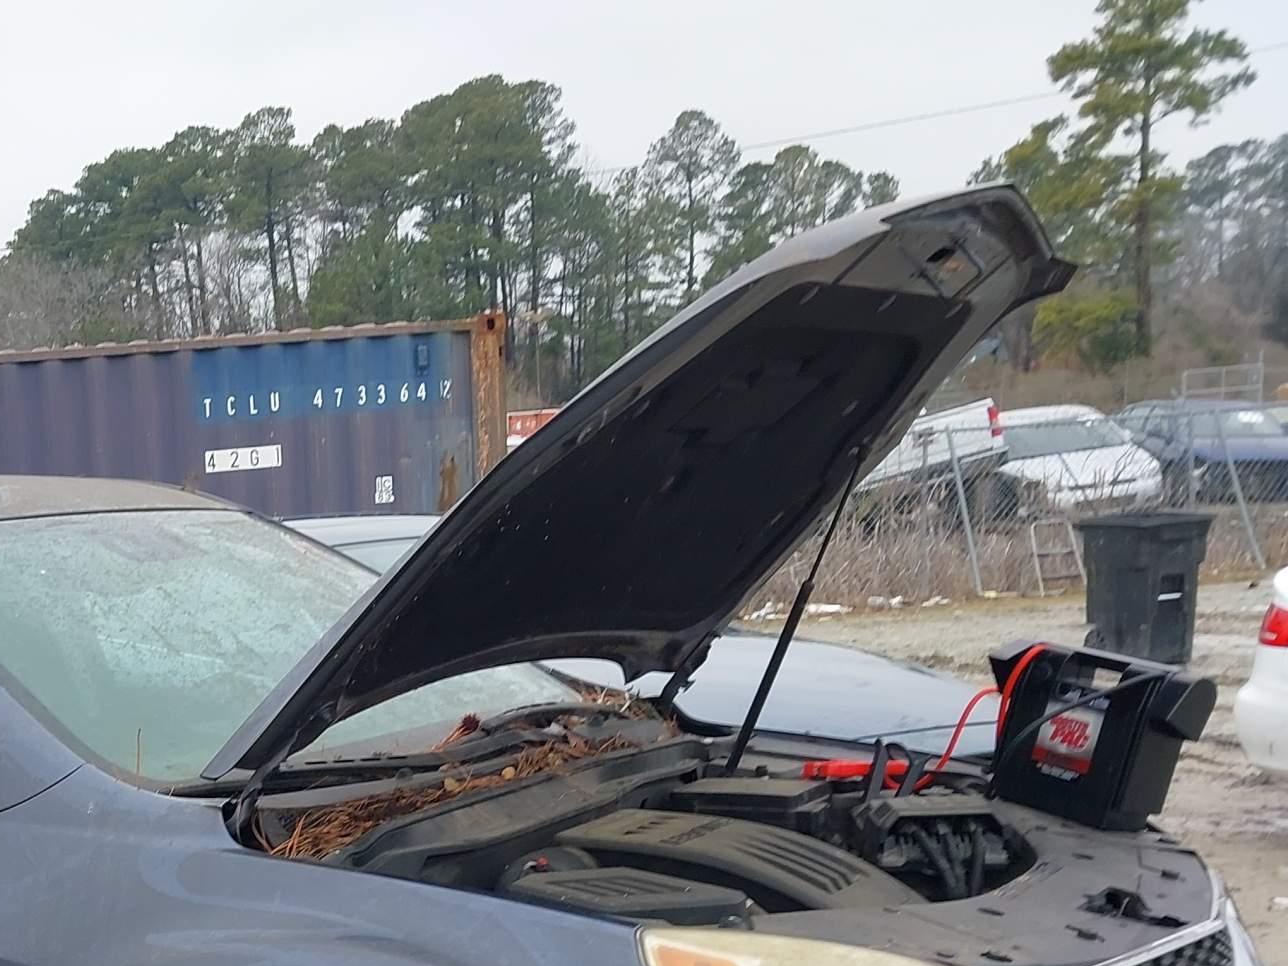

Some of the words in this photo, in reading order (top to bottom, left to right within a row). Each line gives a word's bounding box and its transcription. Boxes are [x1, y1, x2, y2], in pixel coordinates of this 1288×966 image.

[203, 391, 281, 418] TCLU
[313, 382, 427, 409] 473364
[207, 447, 281, 469] 42G1
